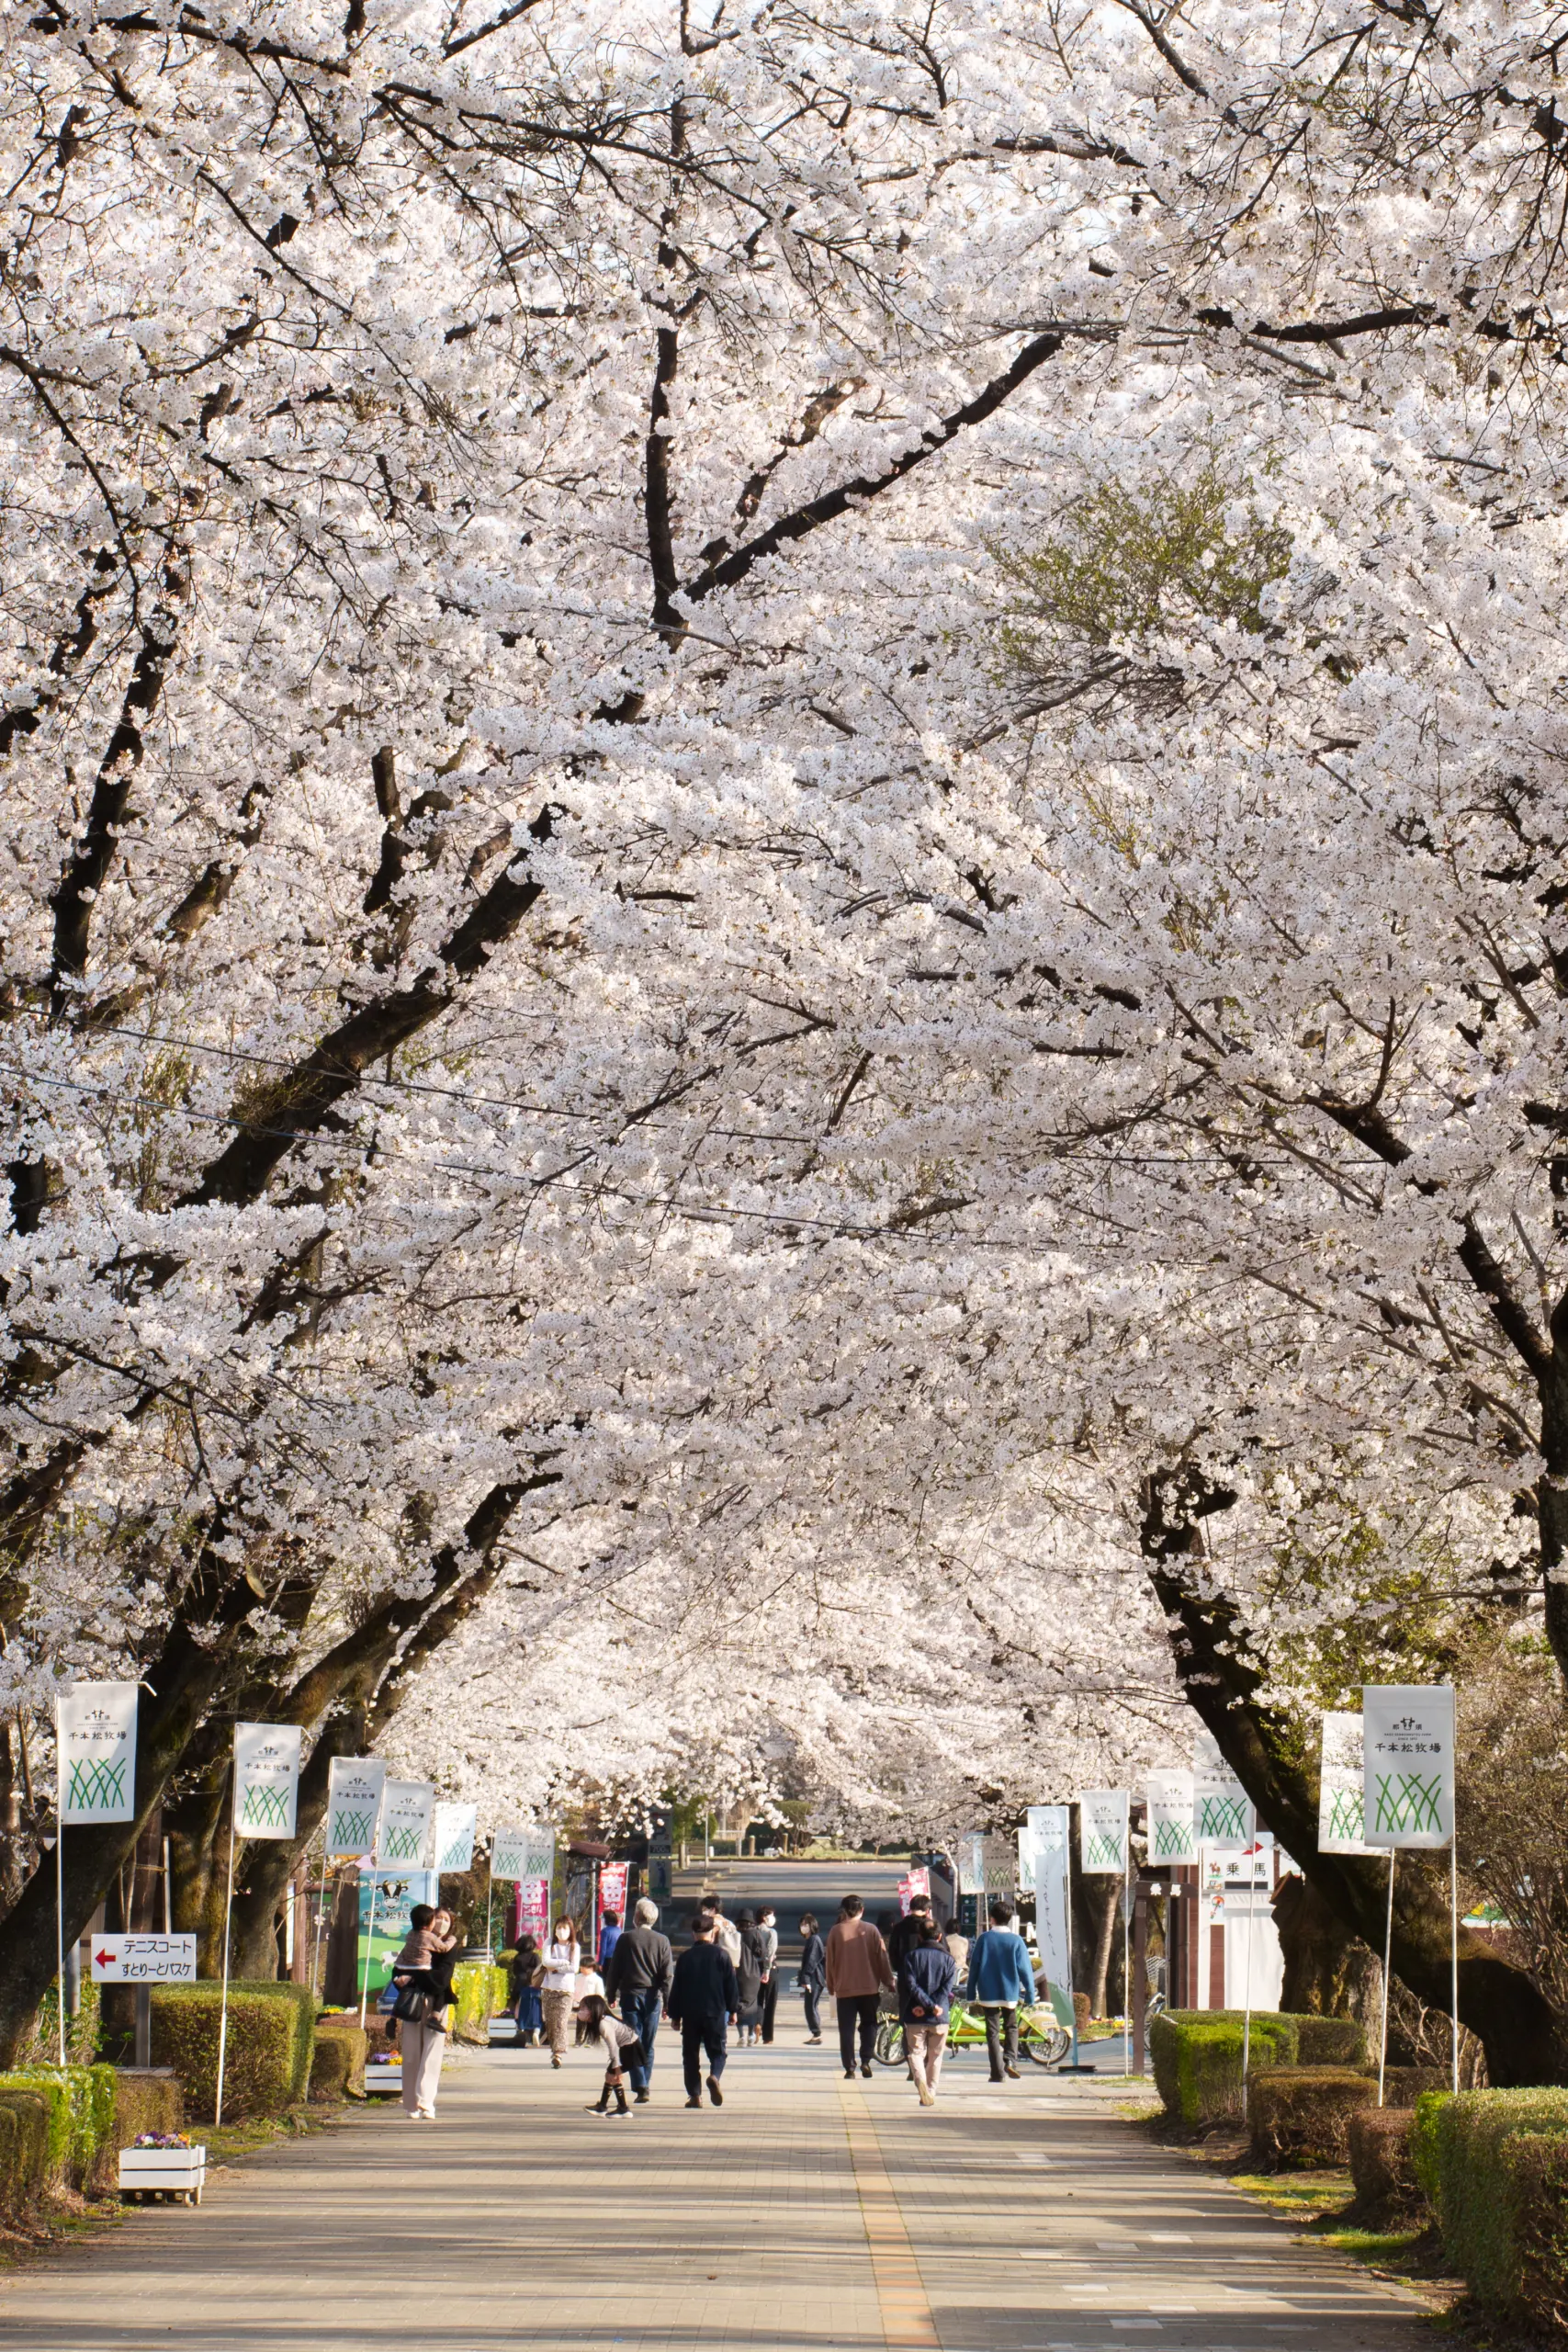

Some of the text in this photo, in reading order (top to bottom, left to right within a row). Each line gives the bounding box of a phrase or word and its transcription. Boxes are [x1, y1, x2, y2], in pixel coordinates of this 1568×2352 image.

[69, 1731, 127, 1740] 千本松牧場
[1375, 1743, 1441, 1753] 千本松牧場
[245, 1762, 290, 1772] 千本松牧場
[336, 1792, 376, 1800] 千本松牧場
[363, 1911, 412, 1920] 千本松牧
[124, 1939, 192, 1954] テニスコート
[121, 1962, 191, 1977] すとりーとバスケ
